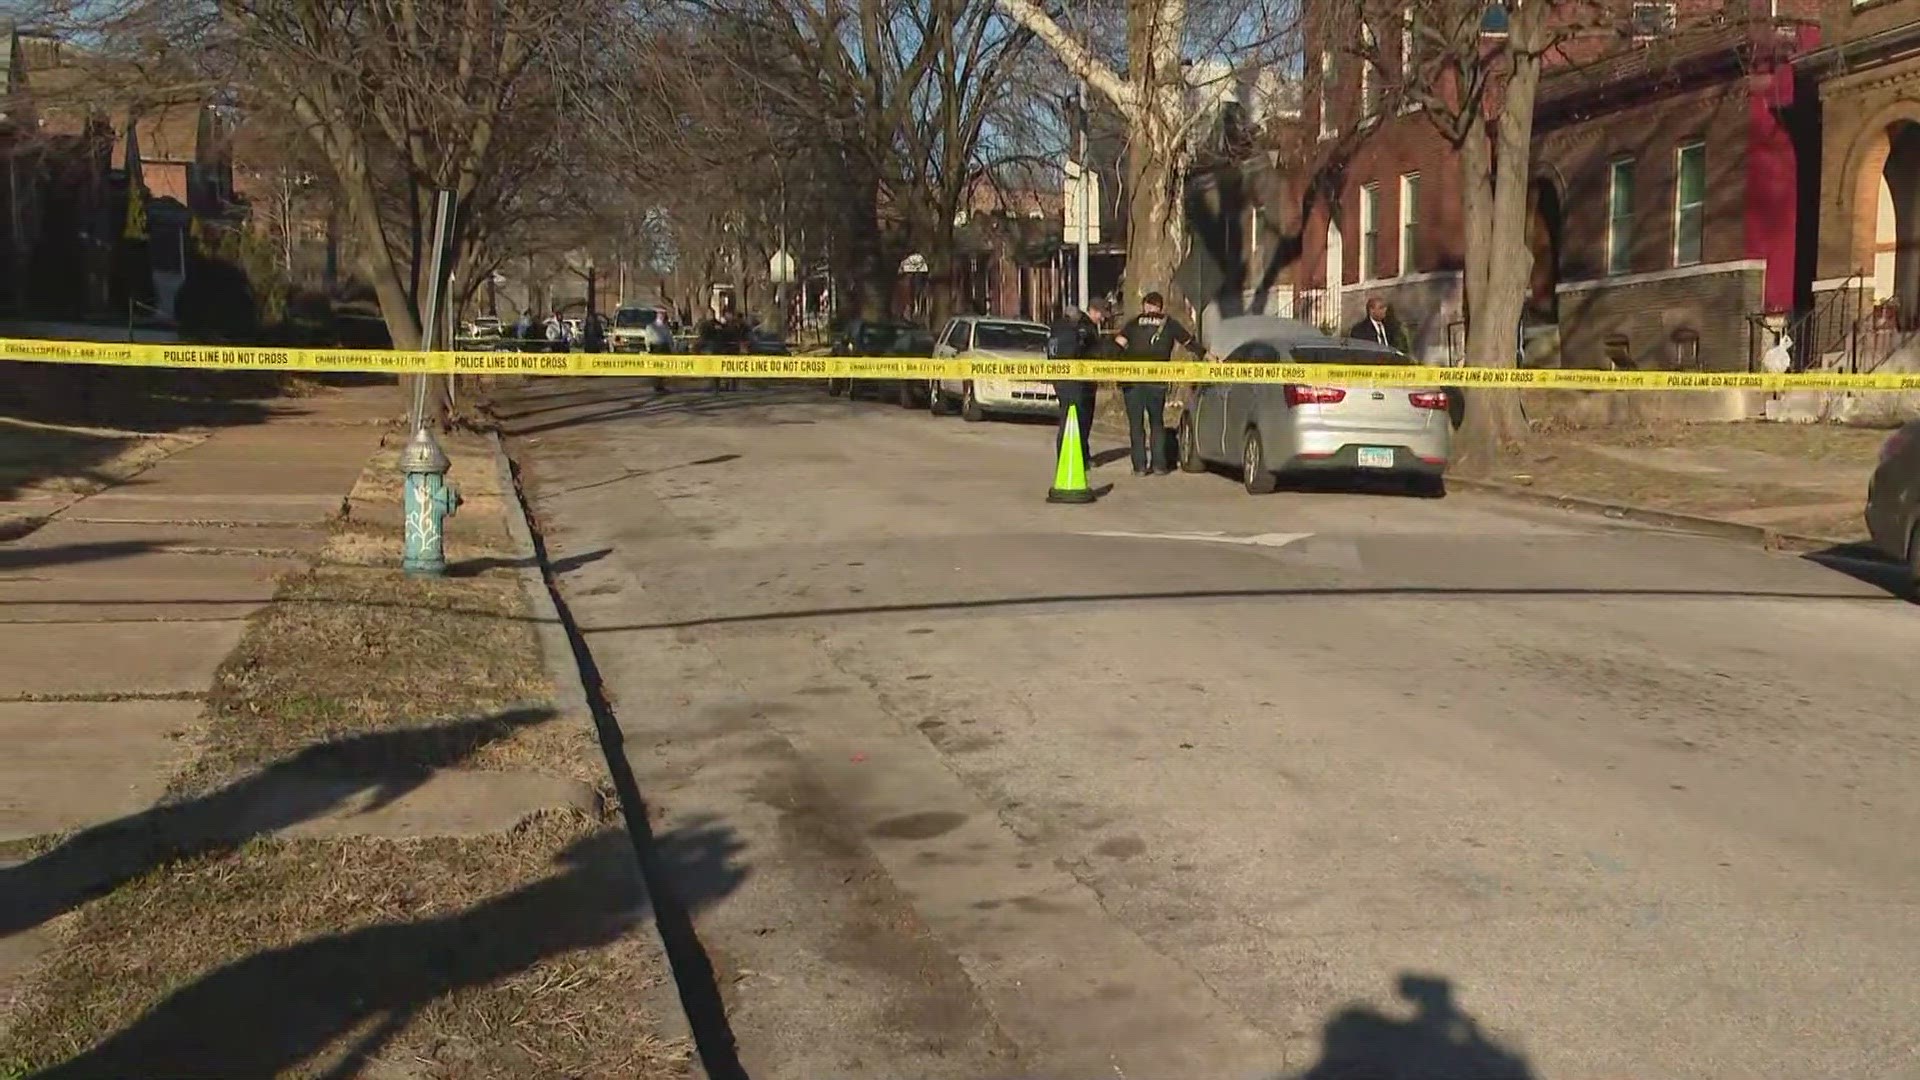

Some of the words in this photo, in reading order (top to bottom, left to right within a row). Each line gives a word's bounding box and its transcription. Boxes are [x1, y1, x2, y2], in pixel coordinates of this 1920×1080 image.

[164, 351, 196, 362] POLICE
[200, 352, 219, 363] LINE
[223, 352, 235, 363] DO
[238, 353, 254, 364] NOT
[258, 353, 288, 364] CROSS
[315, 356, 372, 365] CRIMESTOPPERS
[455, 357, 483, 368] POLICE
[487, 357, 505, 368] LINE
[508, 357, 519, 369] DO
[522, 357, 537, 369] NOT
[541, 357, 567, 369] CROSS
[722, 361, 749, 372] POLICE
[752, 361, 767, 372] LINE
[770, 362, 781, 372] DO
[784, 362, 799, 372] NOT
[801, 362, 826, 372] CROSS
[972, 363, 996, 374] POLICE
[999, 363, 1015, 374] LINE
[1018, 363, 1027, 374] DO
[1030, 363, 1045, 374] NOT
[1047, 364, 1070, 375] CROSS
[1209, 367, 1234, 378] POLICE
[1237, 367, 1252, 378] LINE
[1254, 367, 1264, 378] DO
[1267, 368, 1279, 379] NOT
[1282, 368, 1305, 379] CROSS
[1439, 371, 1463, 381] POLICE
[1465, 371, 1481, 381] LINE
[1484, 372, 1495, 382] DO
[1496, 372, 1510, 382] NOT
[1511, 372, 1534, 382] CROSS
[1667, 376, 1691, 386] POLICE
[1694, 376, 1709, 386] LINE
[1724, 376, 1738, 386] NOT
